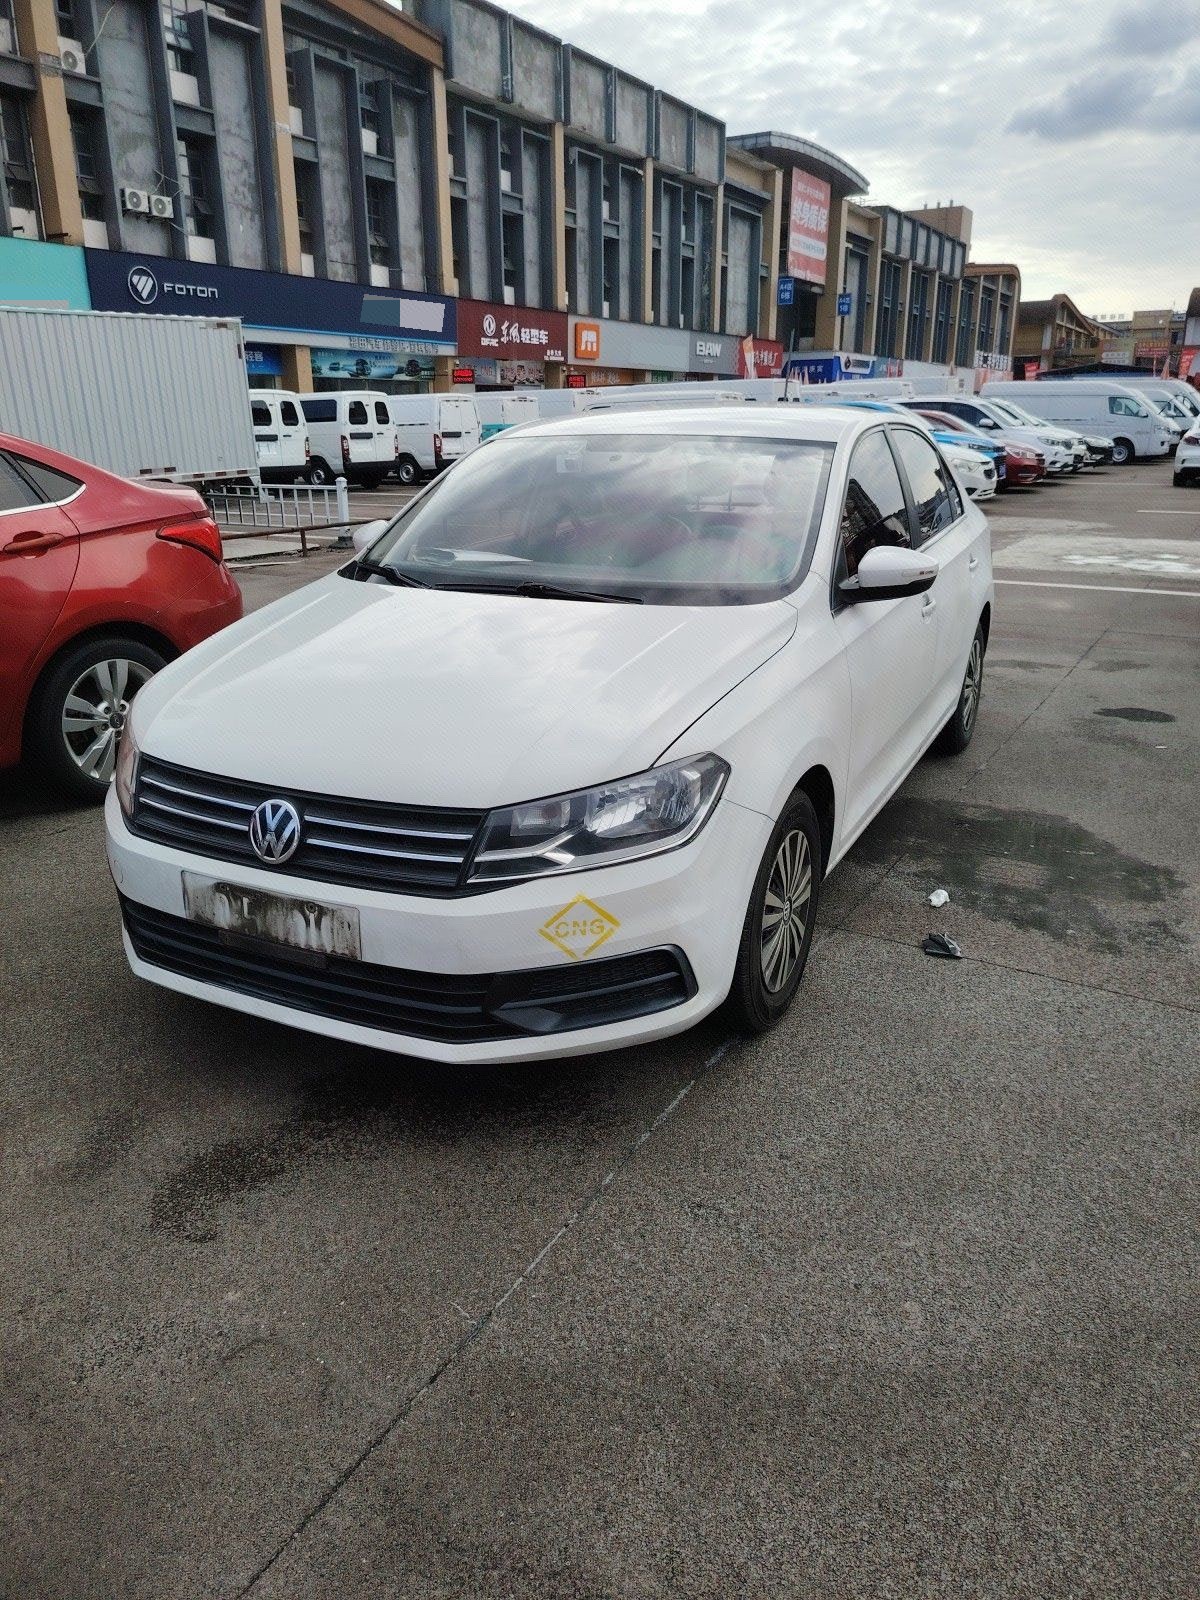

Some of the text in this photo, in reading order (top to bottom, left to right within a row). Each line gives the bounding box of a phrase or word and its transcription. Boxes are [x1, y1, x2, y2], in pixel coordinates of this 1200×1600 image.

[163, 282, 218, 299] FOTON
[696, 341, 721, 357] BAW
[555, 919, 605, 938] CNG
